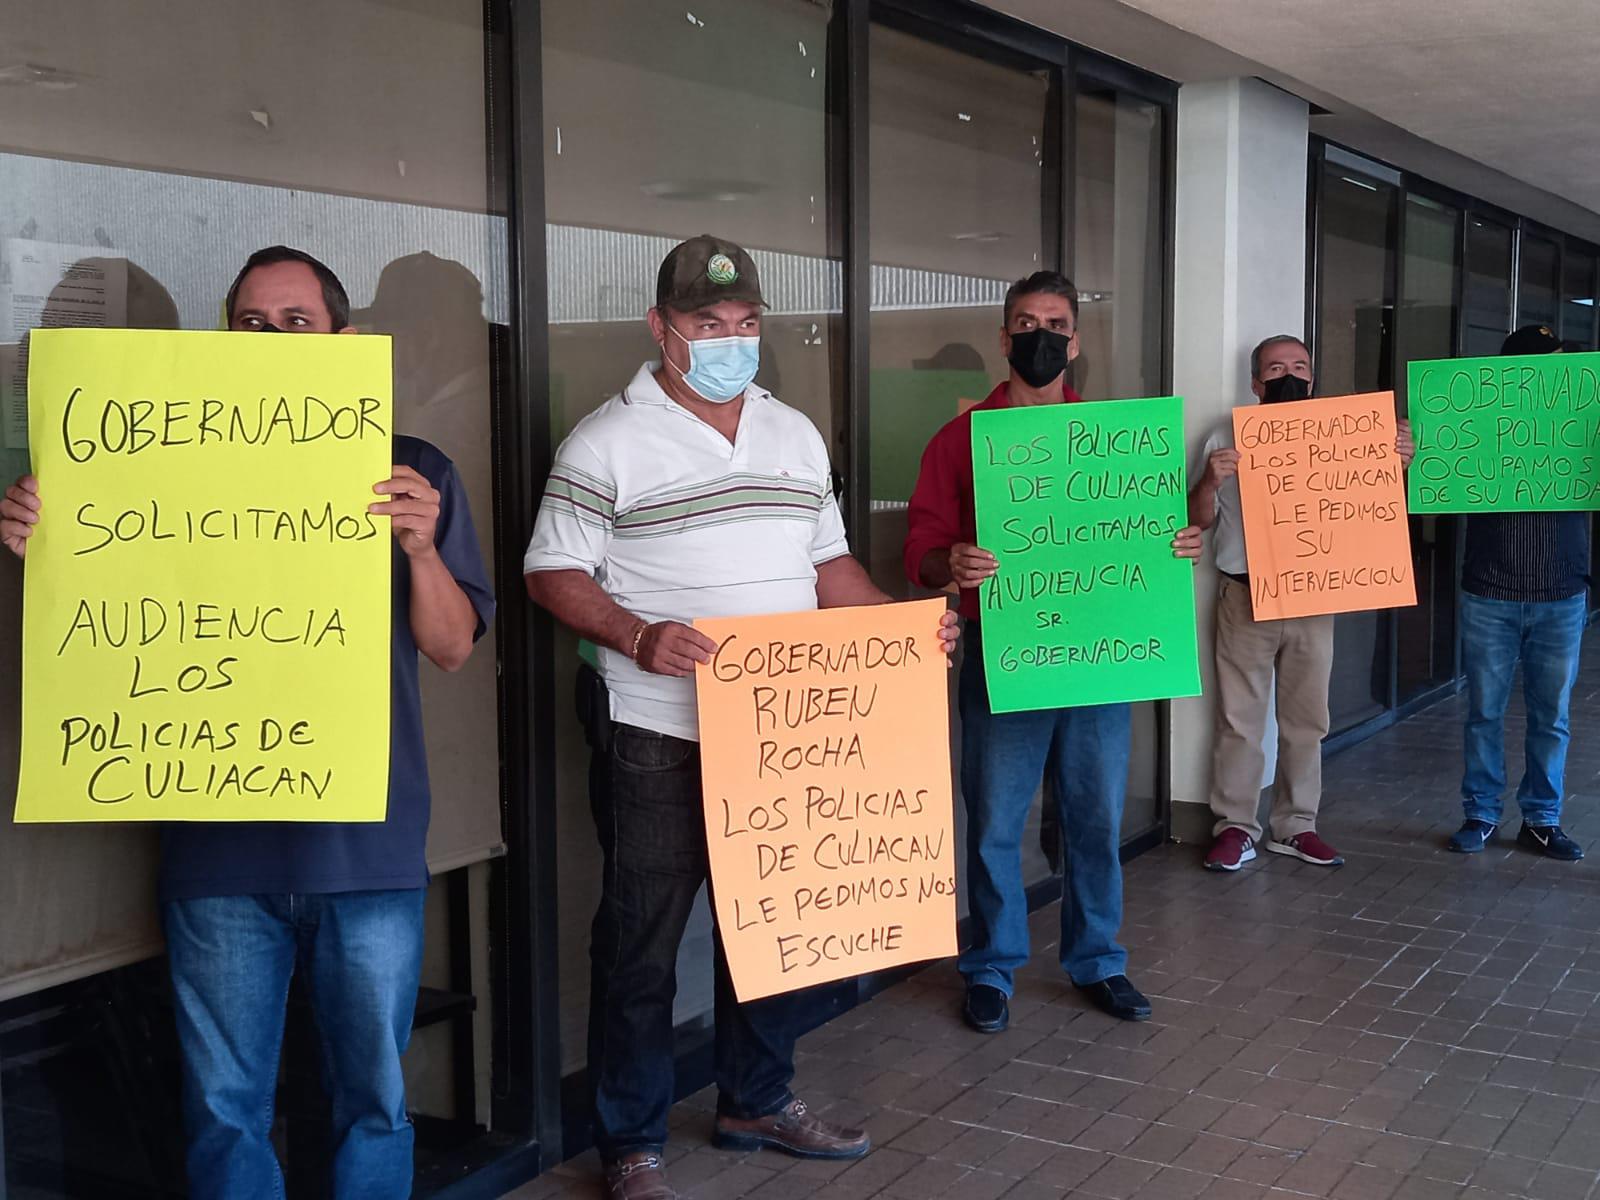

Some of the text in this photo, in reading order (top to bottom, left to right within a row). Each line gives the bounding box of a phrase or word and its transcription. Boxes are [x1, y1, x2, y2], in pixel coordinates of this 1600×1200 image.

[1418, 365, 1600, 414] GOBERNAD
[61, 387, 387, 463] GOBERNADOR
[984, 419, 1171, 467] LOS POLICIAS
[1240, 409, 1385, 449] GOBERNADOR
[1418, 419, 1481, 451] LOS
[1249, 442, 1389, 471] LOS POLICIAS
[1265, 464, 1399, 496] DE CULIACAN
[1420, 454, 1595, 482] OCUPAMOS
[1007, 466, 1185, 504] DE CULIACAN
[1418, 485, 1452, 505] DE
[1465, 484, 1502, 505] SU
[73, 499, 379, 556] SOLICITAMOS
[1001, 513, 1177, 554] SOLICITAMOS
[1271, 497, 1400, 526] LE PEDIMOS
[1295, 529, 1334, 558] SU
[987, 563, 1149, 611] AUDIENCIA
[1254, 565, 1407, 609] INTERVENCION
[57, 597, 347, 657] AUDIENCIA
[1036, 610, 1070, 630] SR.
[129, 655, 239, 699] LOS
[711, 634, 921, 683] GOBERNADOR
[998, 637, 1166, 673] GOBERNADOR
[752, 683, 878, 735] RUBEN
[60, 711, 316, 767] POLICIAS DE
[758, 732, 866, 780] ROCHA
[87, 755, 334, 805] CULIACAN
[722, 785, 930, 838] LOS POLICIAS
[756, 827, 945, 881] DE CULIACAN
[734, 872, 957, 932] LE PEDIMOS NOS
[776, 924, 904, 974] ESCUCHE
